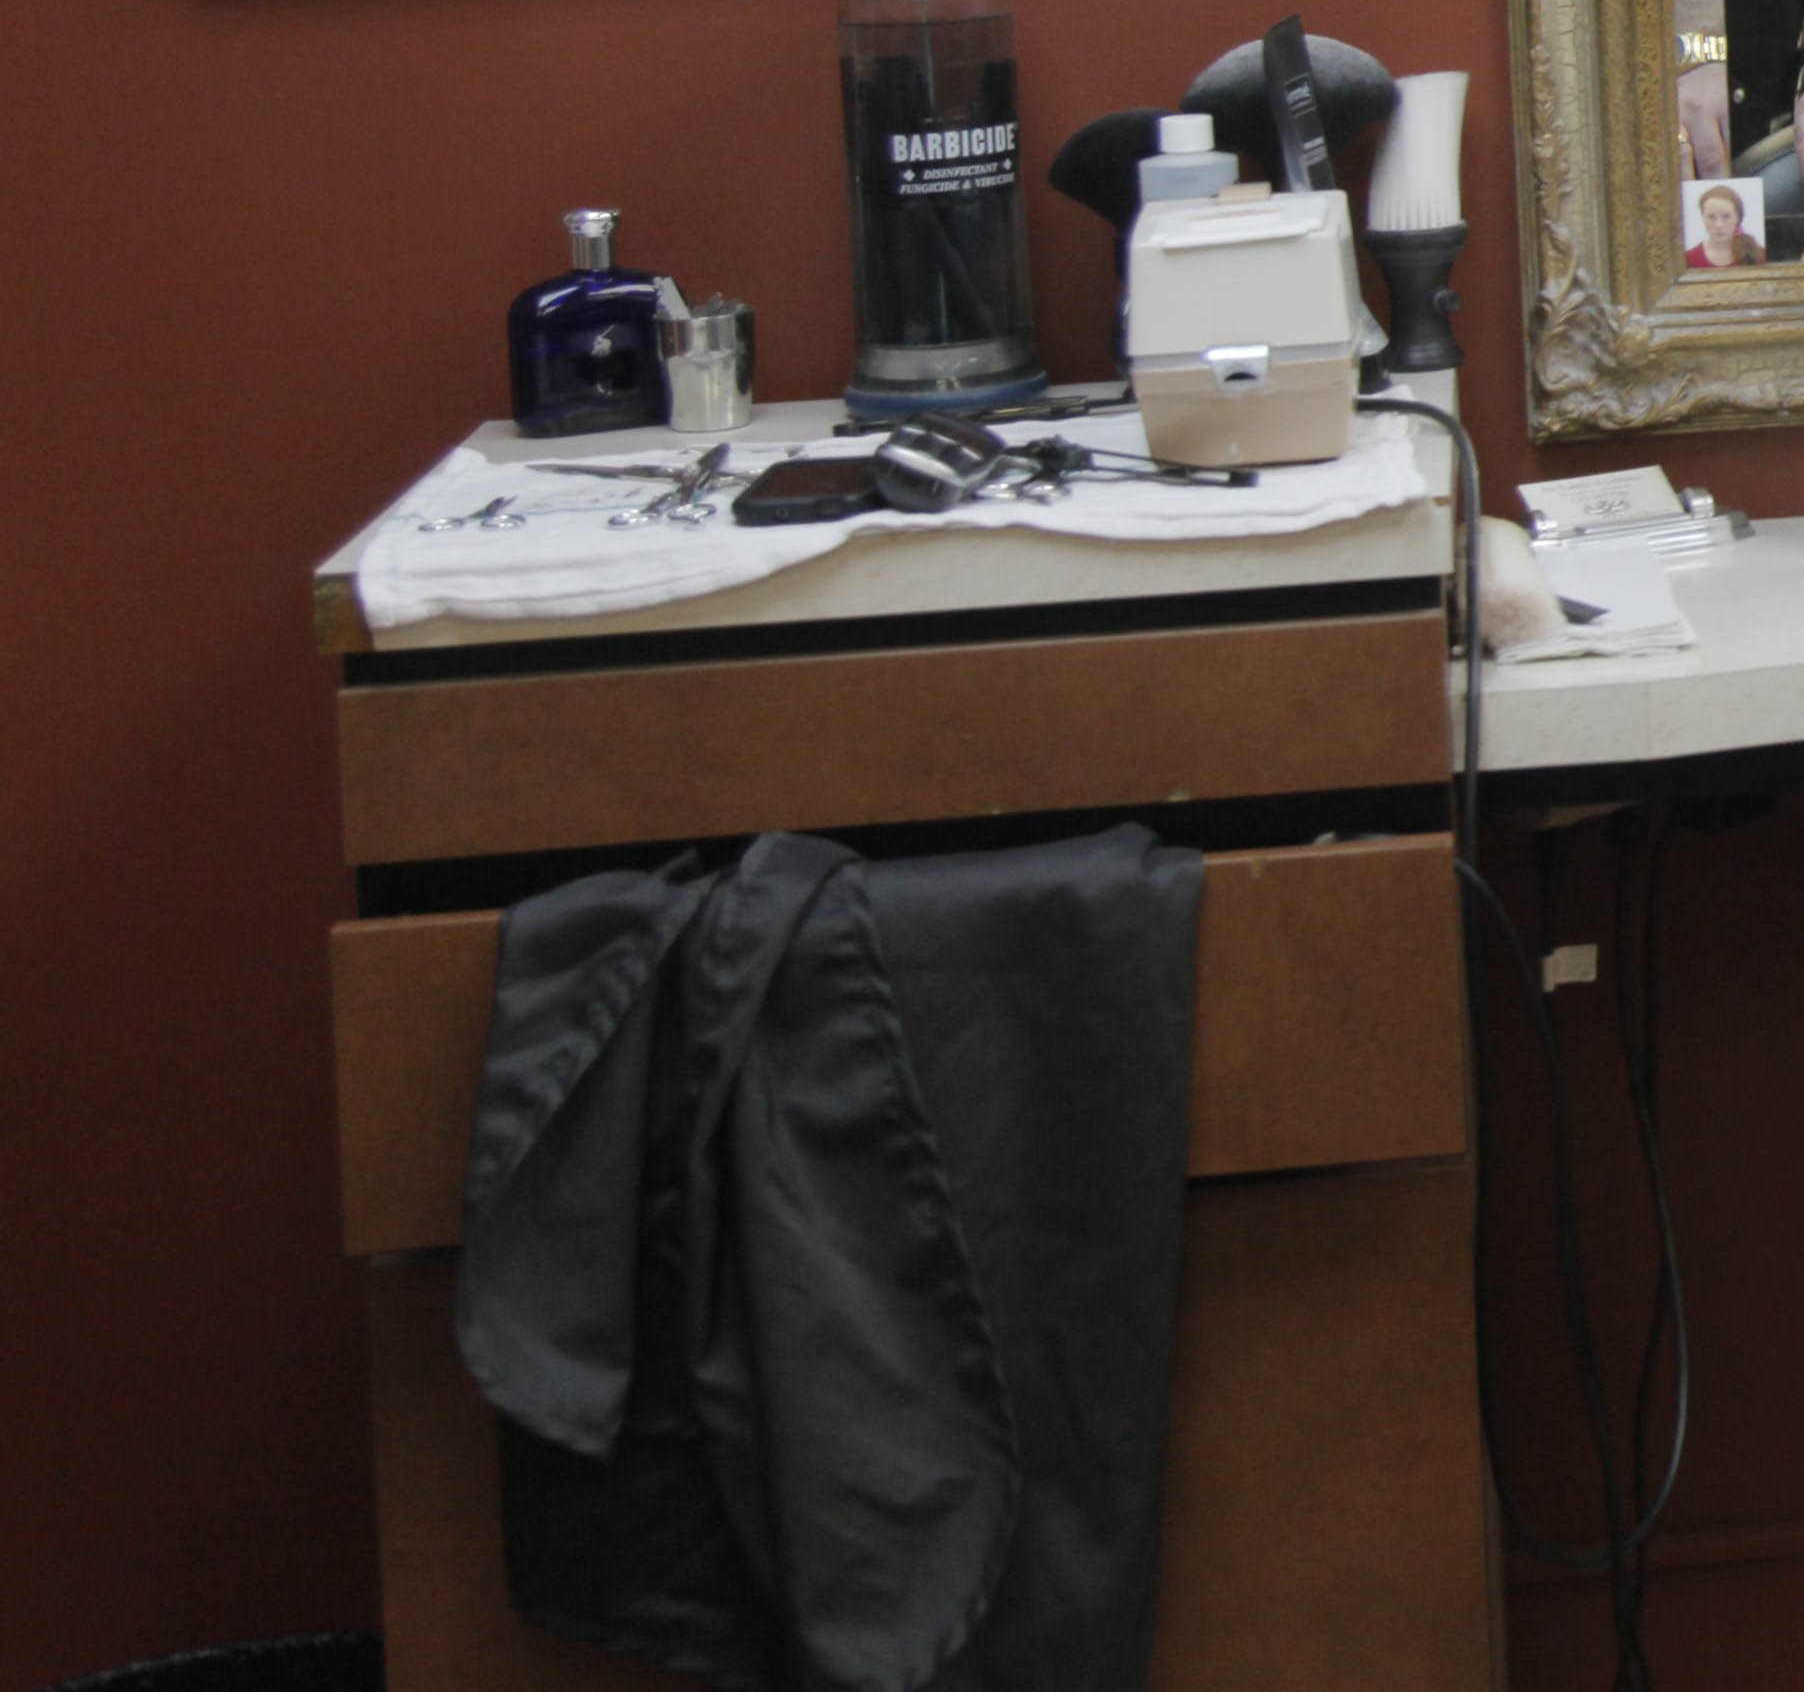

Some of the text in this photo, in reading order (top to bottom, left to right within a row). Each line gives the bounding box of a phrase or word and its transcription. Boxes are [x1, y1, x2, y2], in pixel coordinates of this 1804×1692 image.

[893, 123, 1016, 162] BARBICIDE
[923, 162, 999, 180] DISINFECTANT
[899, 180, 960, 195] FUNGICIDE
